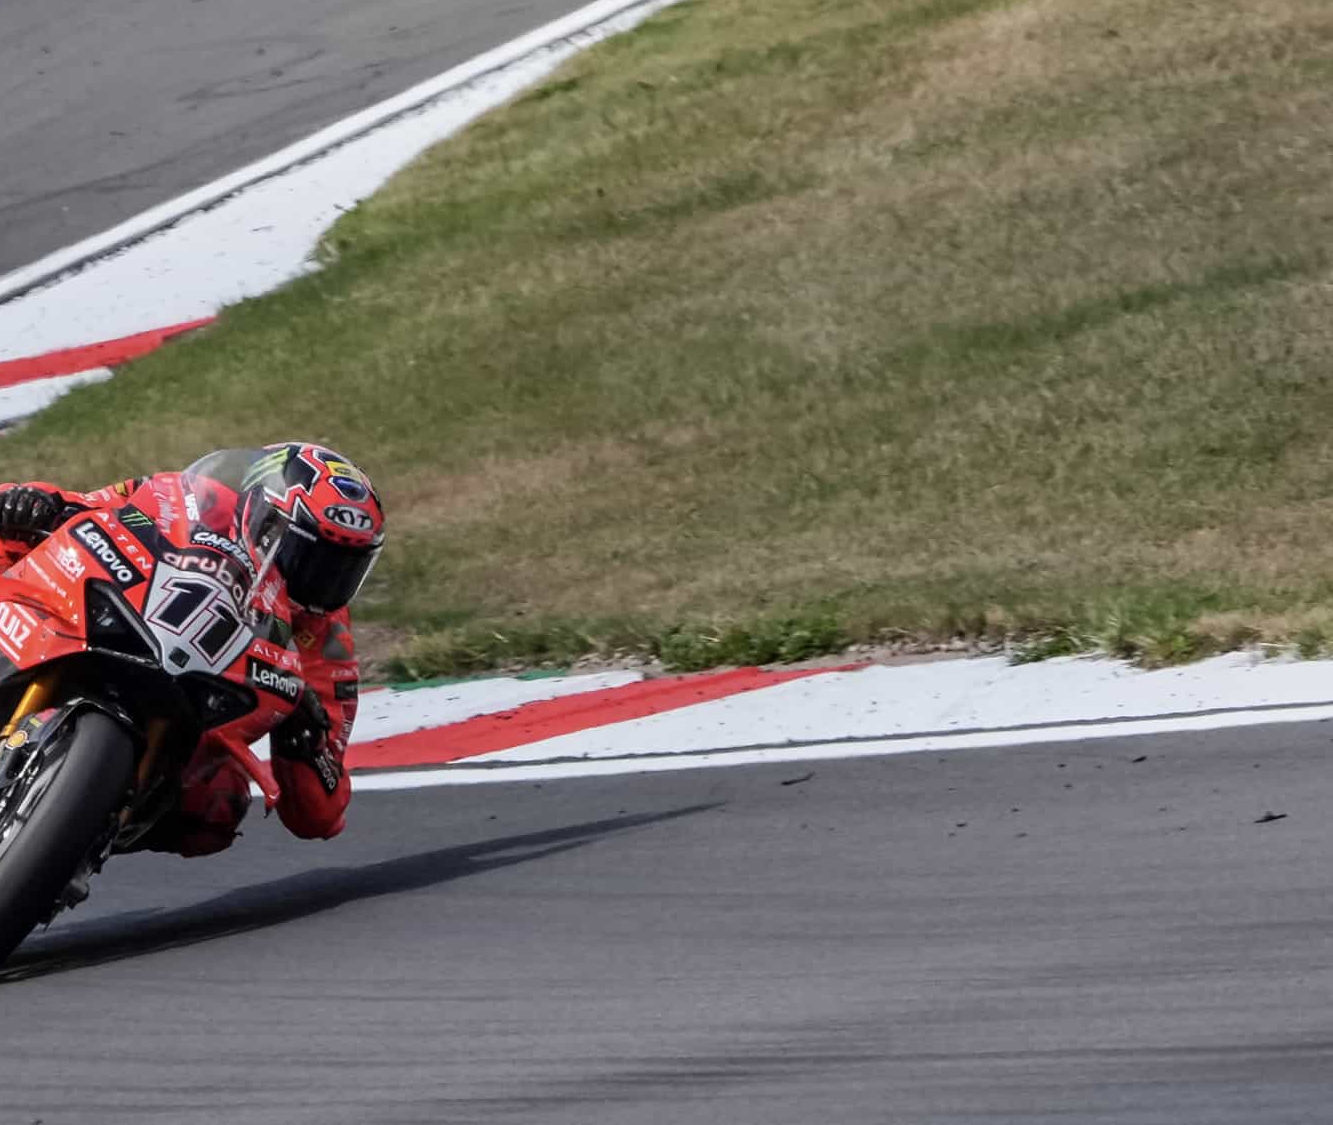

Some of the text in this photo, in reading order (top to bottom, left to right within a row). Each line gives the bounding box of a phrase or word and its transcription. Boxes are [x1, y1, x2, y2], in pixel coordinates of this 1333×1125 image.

[96, 512, 152, 570] ALTEN
[325, 505, 373, 530] KYT
[75, 522, 133, 582] Lenovo
[147, 577, 246, 667] 11
[252, 662, 297, 697] Lenovo
